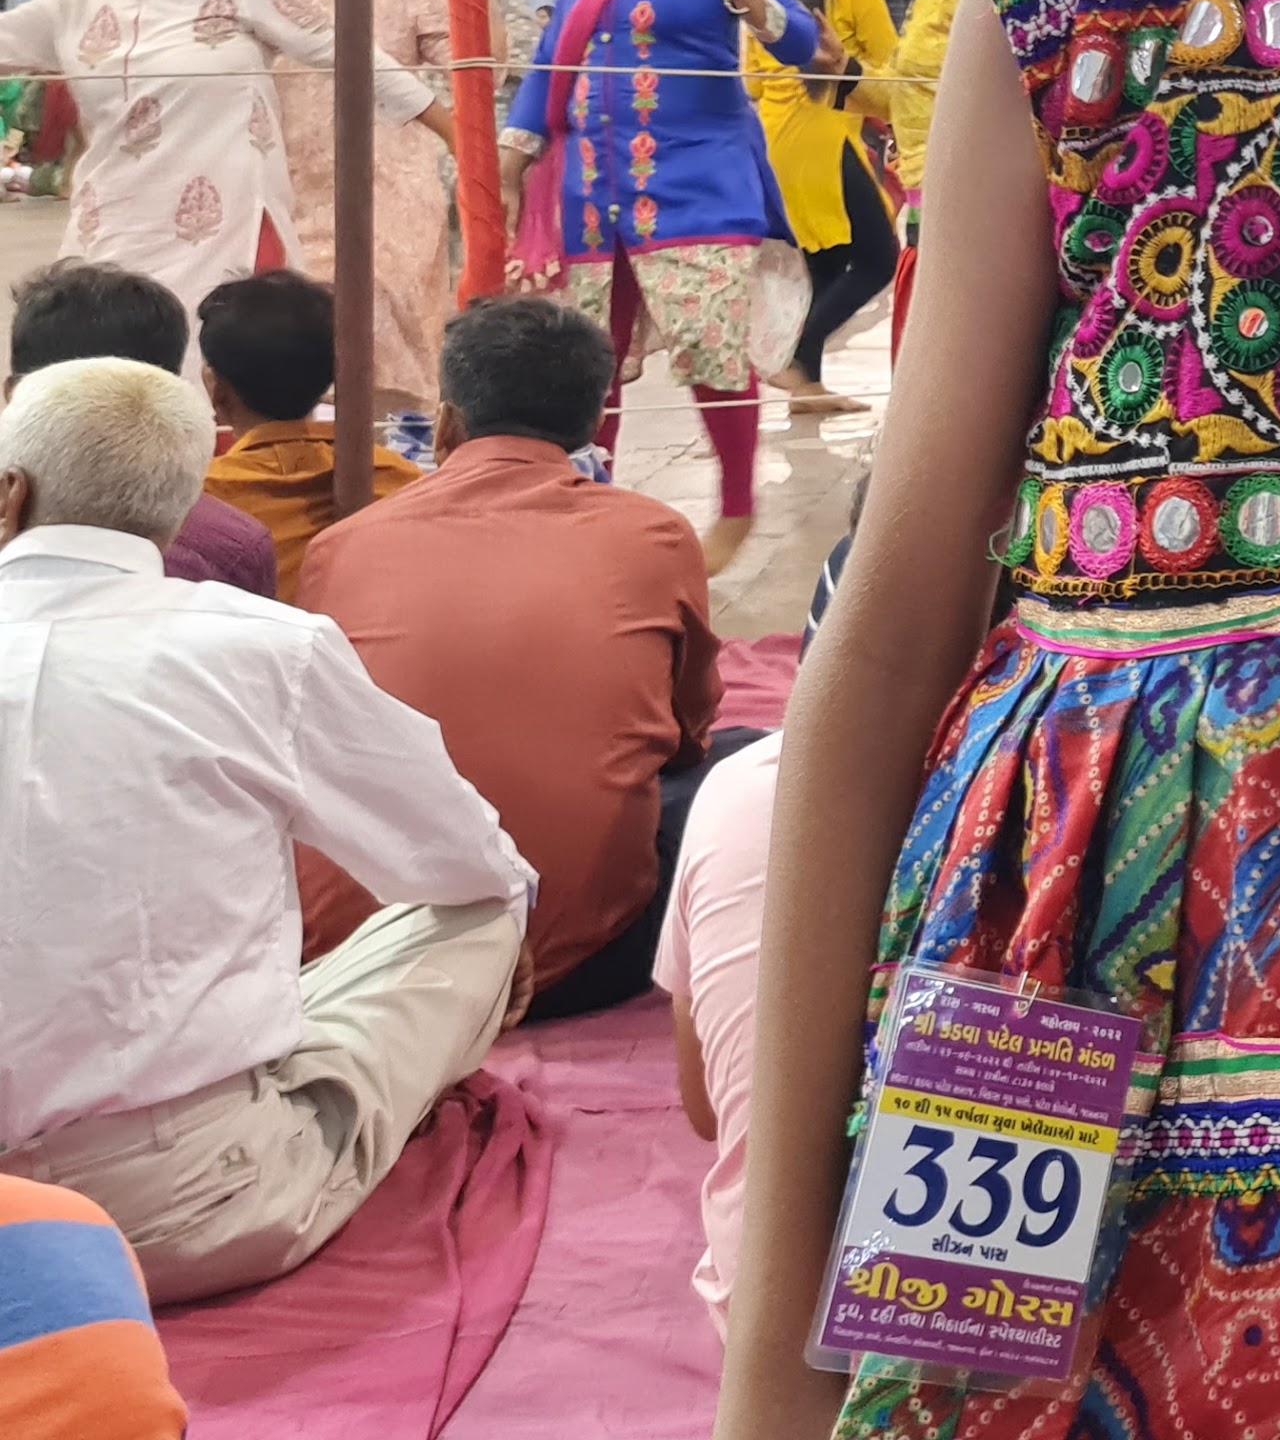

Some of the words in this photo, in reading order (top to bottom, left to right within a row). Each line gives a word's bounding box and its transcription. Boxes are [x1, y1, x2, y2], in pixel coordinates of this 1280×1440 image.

[913, 1011, 936, 1038] શ્રી
[938, 1018, 981, 1046] કડવા
[986, 1022, 1024, 1054] પટેલ
[1027, 1035, 1074, 1063] પ્રગતિ
[1077, 1040, 1117, 1072] મંડળ
[1077, 1126, 1101, 1146] માટે
[881, 1123, 1083, 1249] 339
[930, 1234, 975, 1259] સીઝન
[978, 1243, 1009, 1263] પાસ
[843, 1260, 950, 1312] શ્રીજી
[961, 1277, 1076, 1328] ગોરસ
[898, 1311, 925, 1329] તથા
